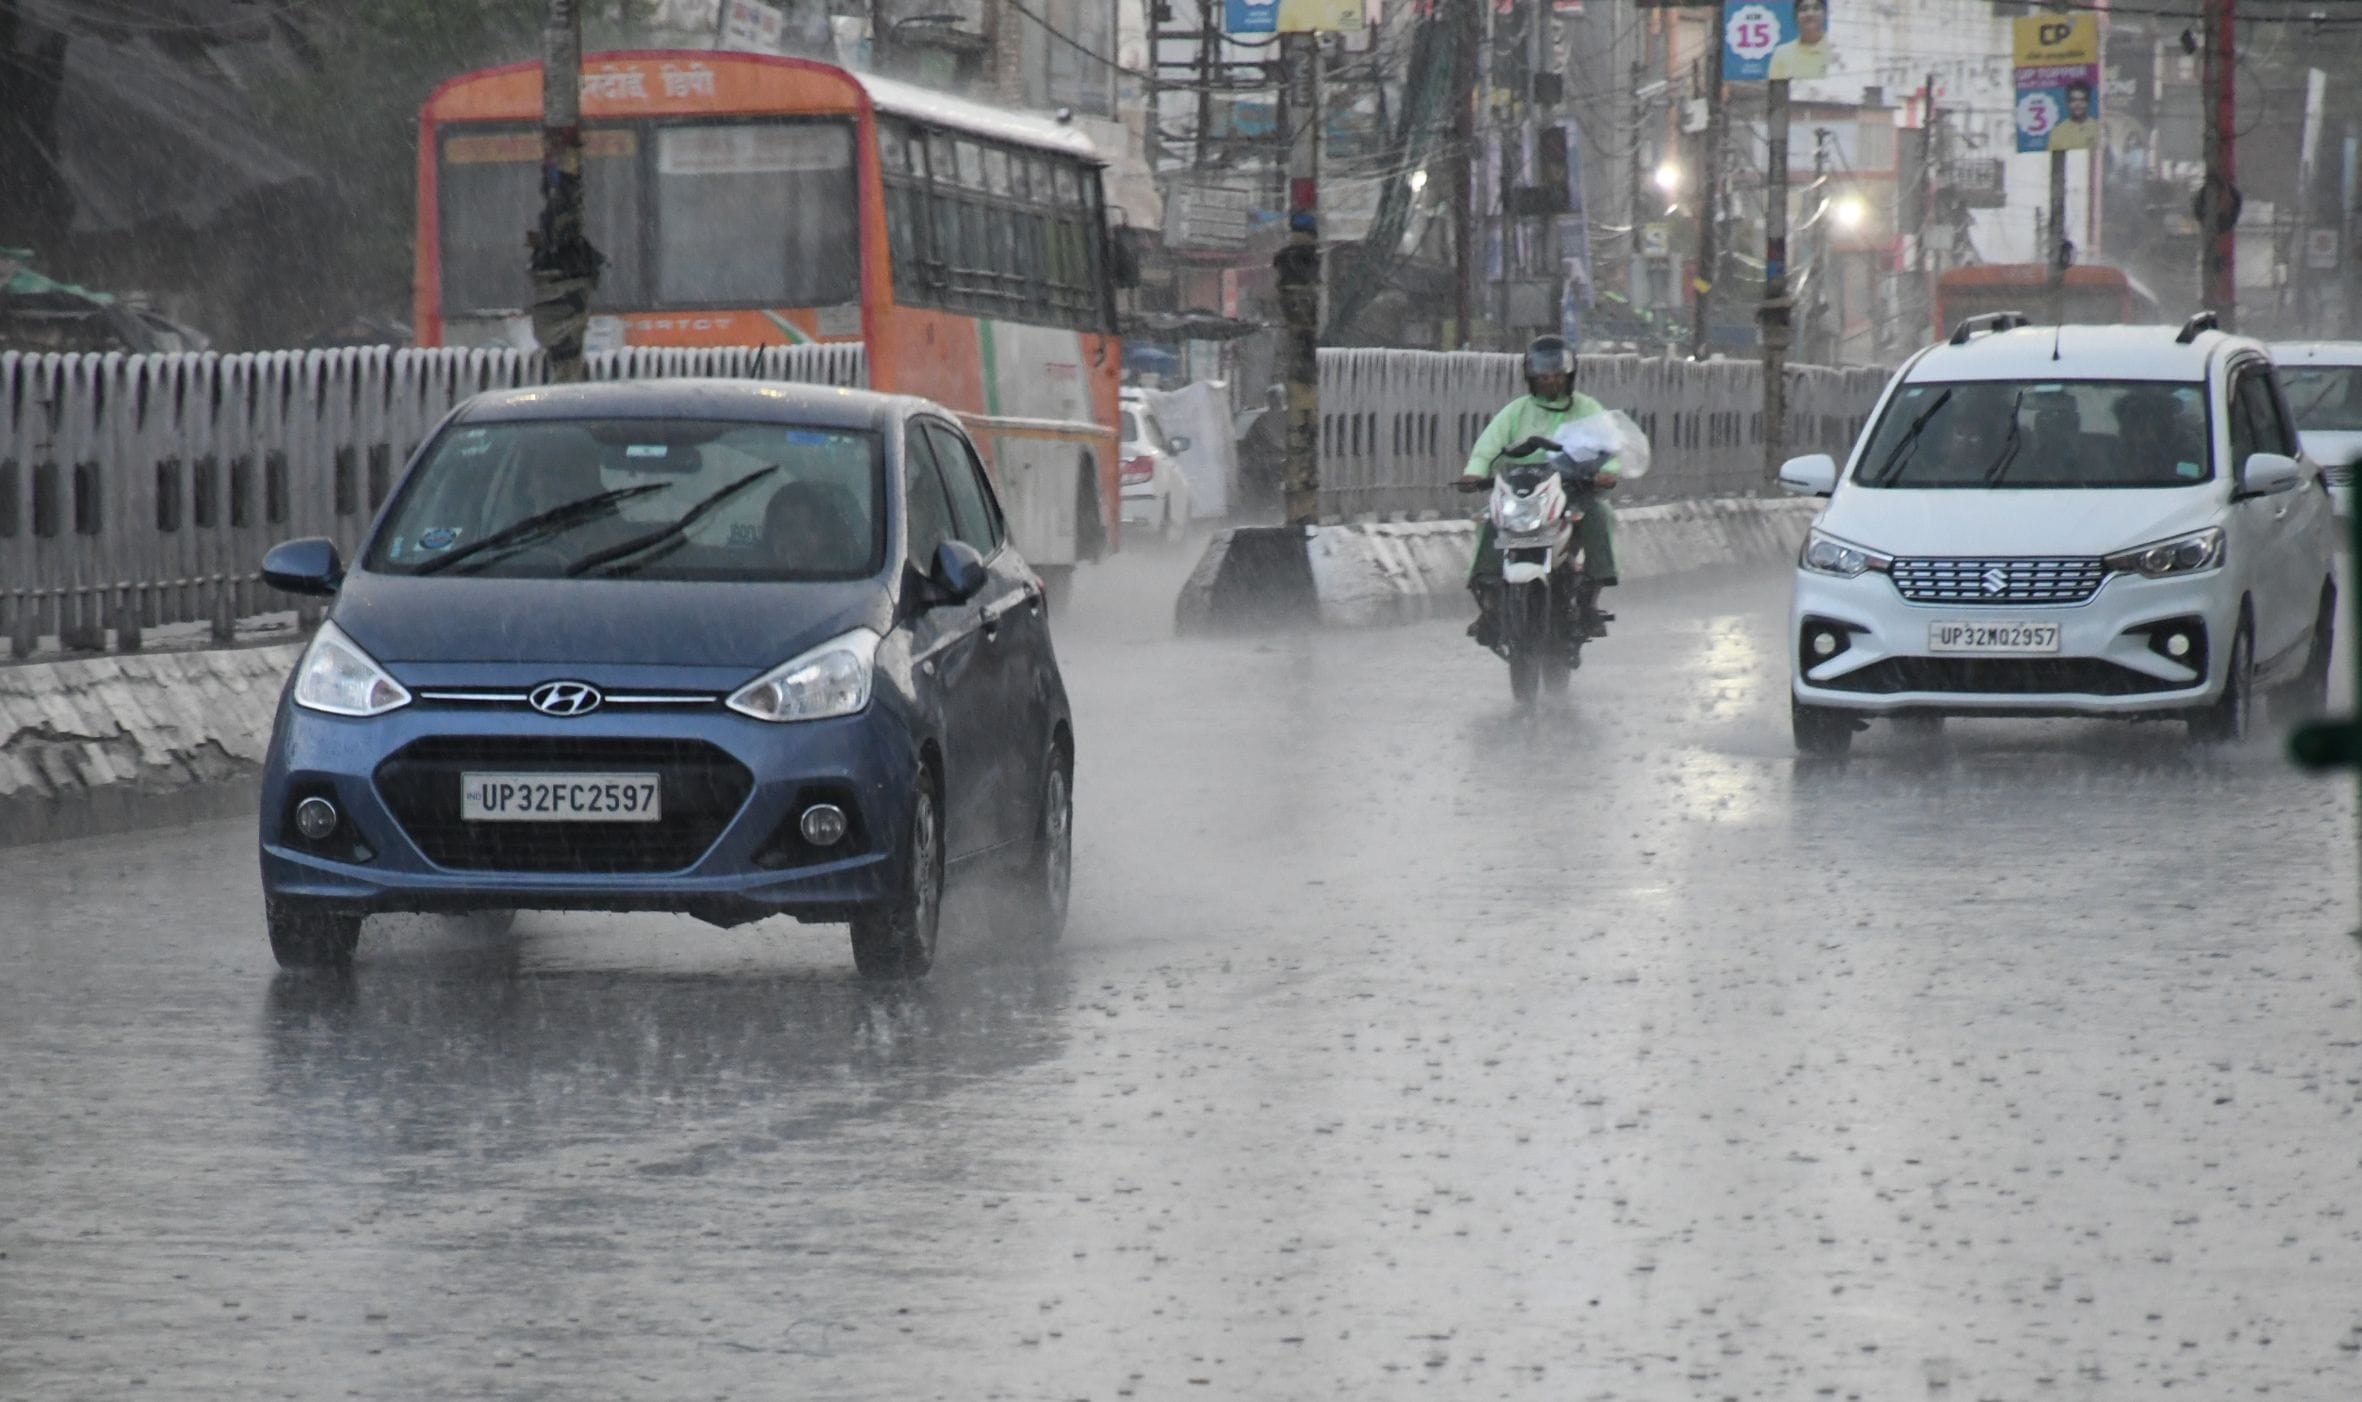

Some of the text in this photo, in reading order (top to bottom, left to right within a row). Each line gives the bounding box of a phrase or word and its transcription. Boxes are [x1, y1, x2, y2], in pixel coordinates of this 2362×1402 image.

[1736, 23, 1771, 48] 15
[2038, 23, 2072, 46] CP
[2026, 106, 2049, 132] 3
[1941, 627, 2057, 647] UP32MQ2957
[482, 783, 655, 812] UP32FC2597
